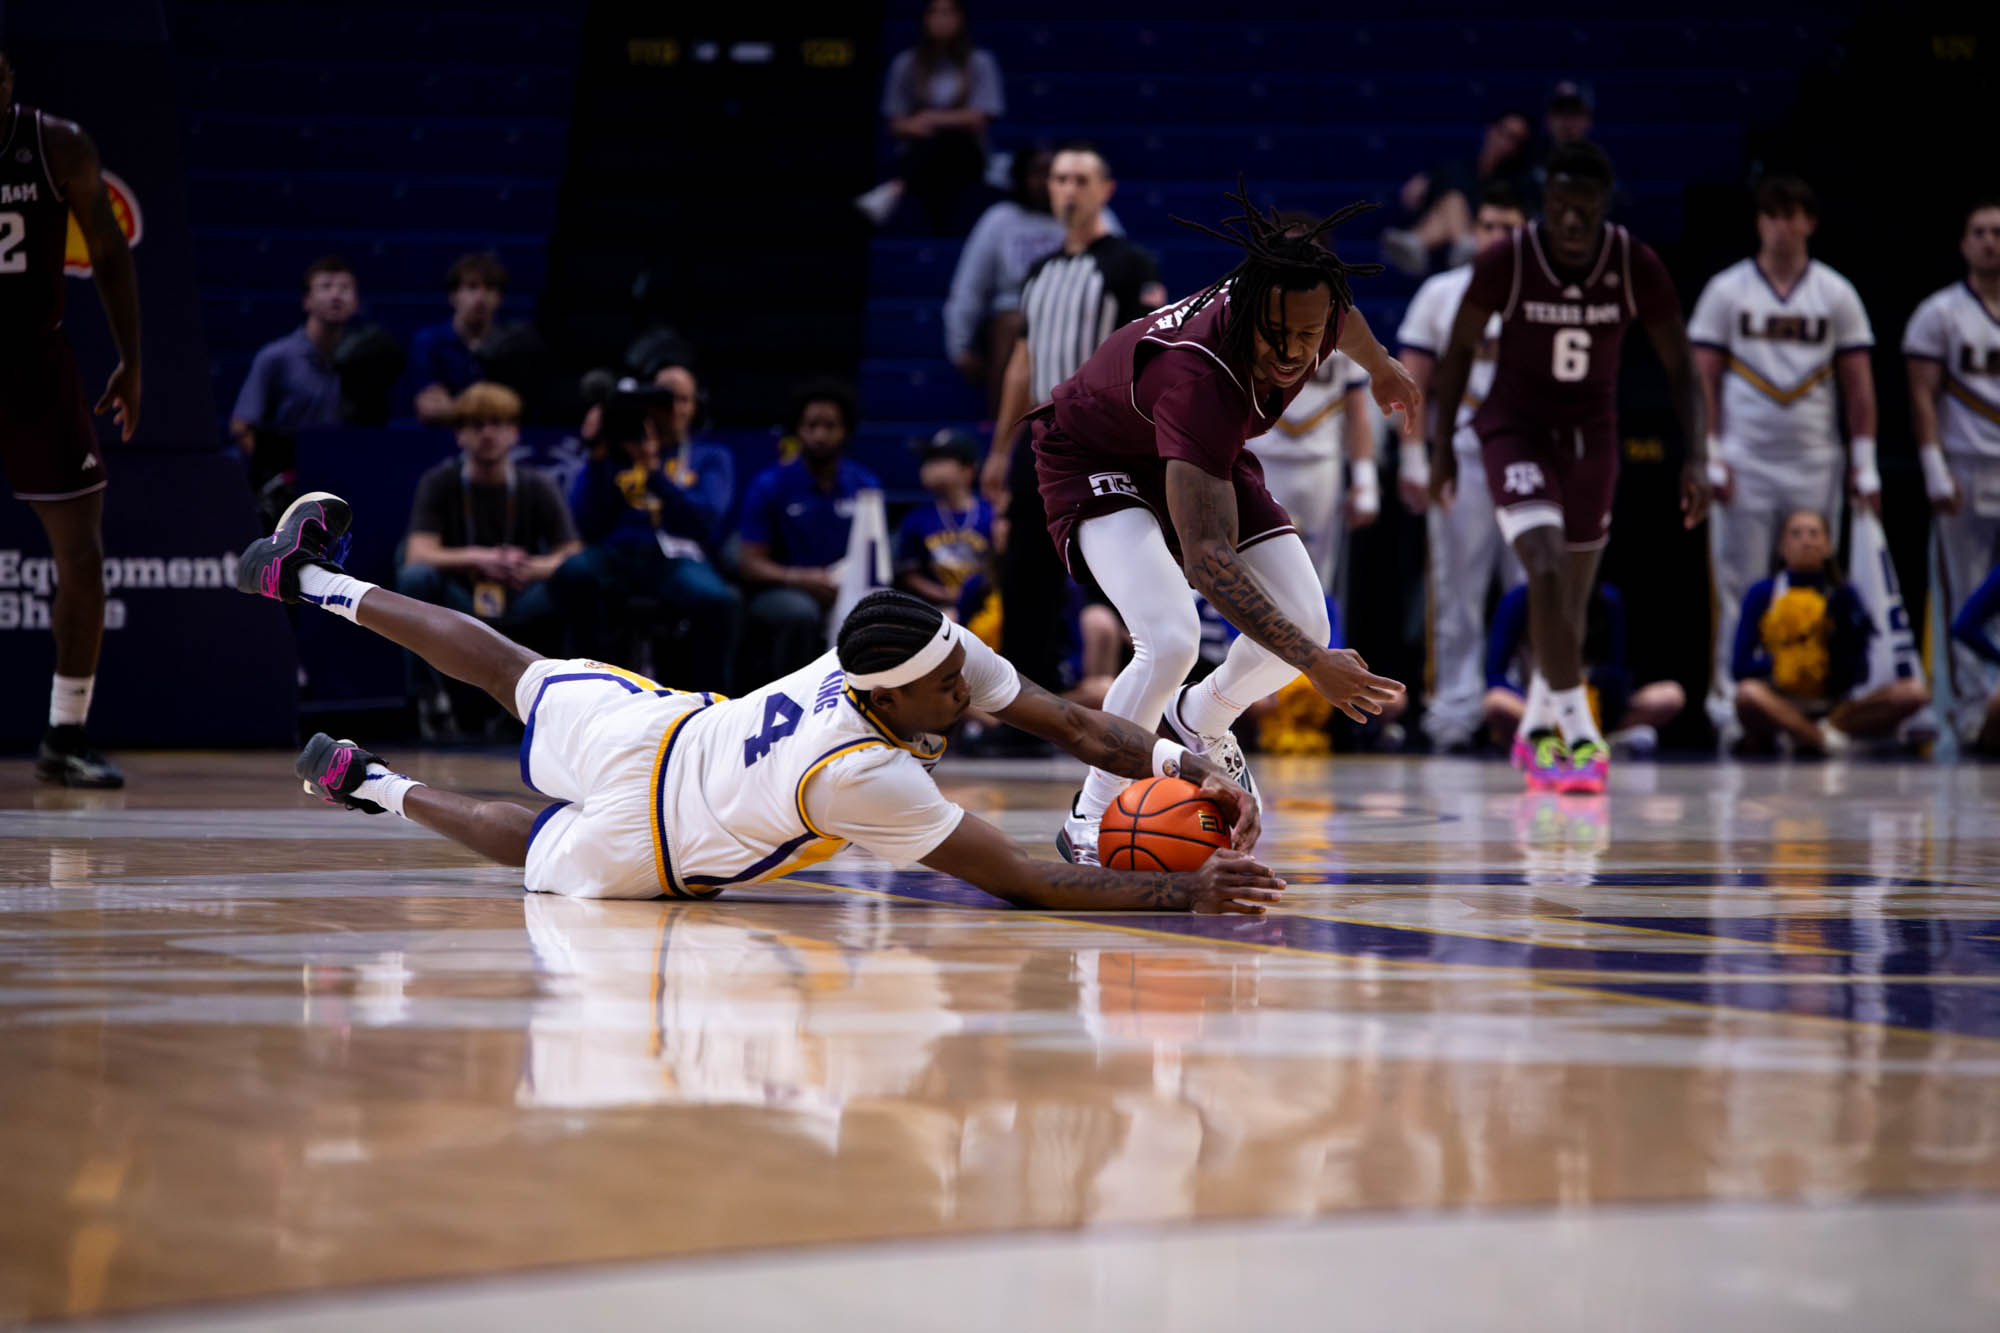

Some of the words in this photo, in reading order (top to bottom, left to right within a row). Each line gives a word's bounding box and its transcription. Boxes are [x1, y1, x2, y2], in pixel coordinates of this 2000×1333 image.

[1551, 327, 1593, 382] 6
[0, 549, 240, 597] Eqpment
[0, 592, 127, 631] She
[744, 691, 804, 768] 4
